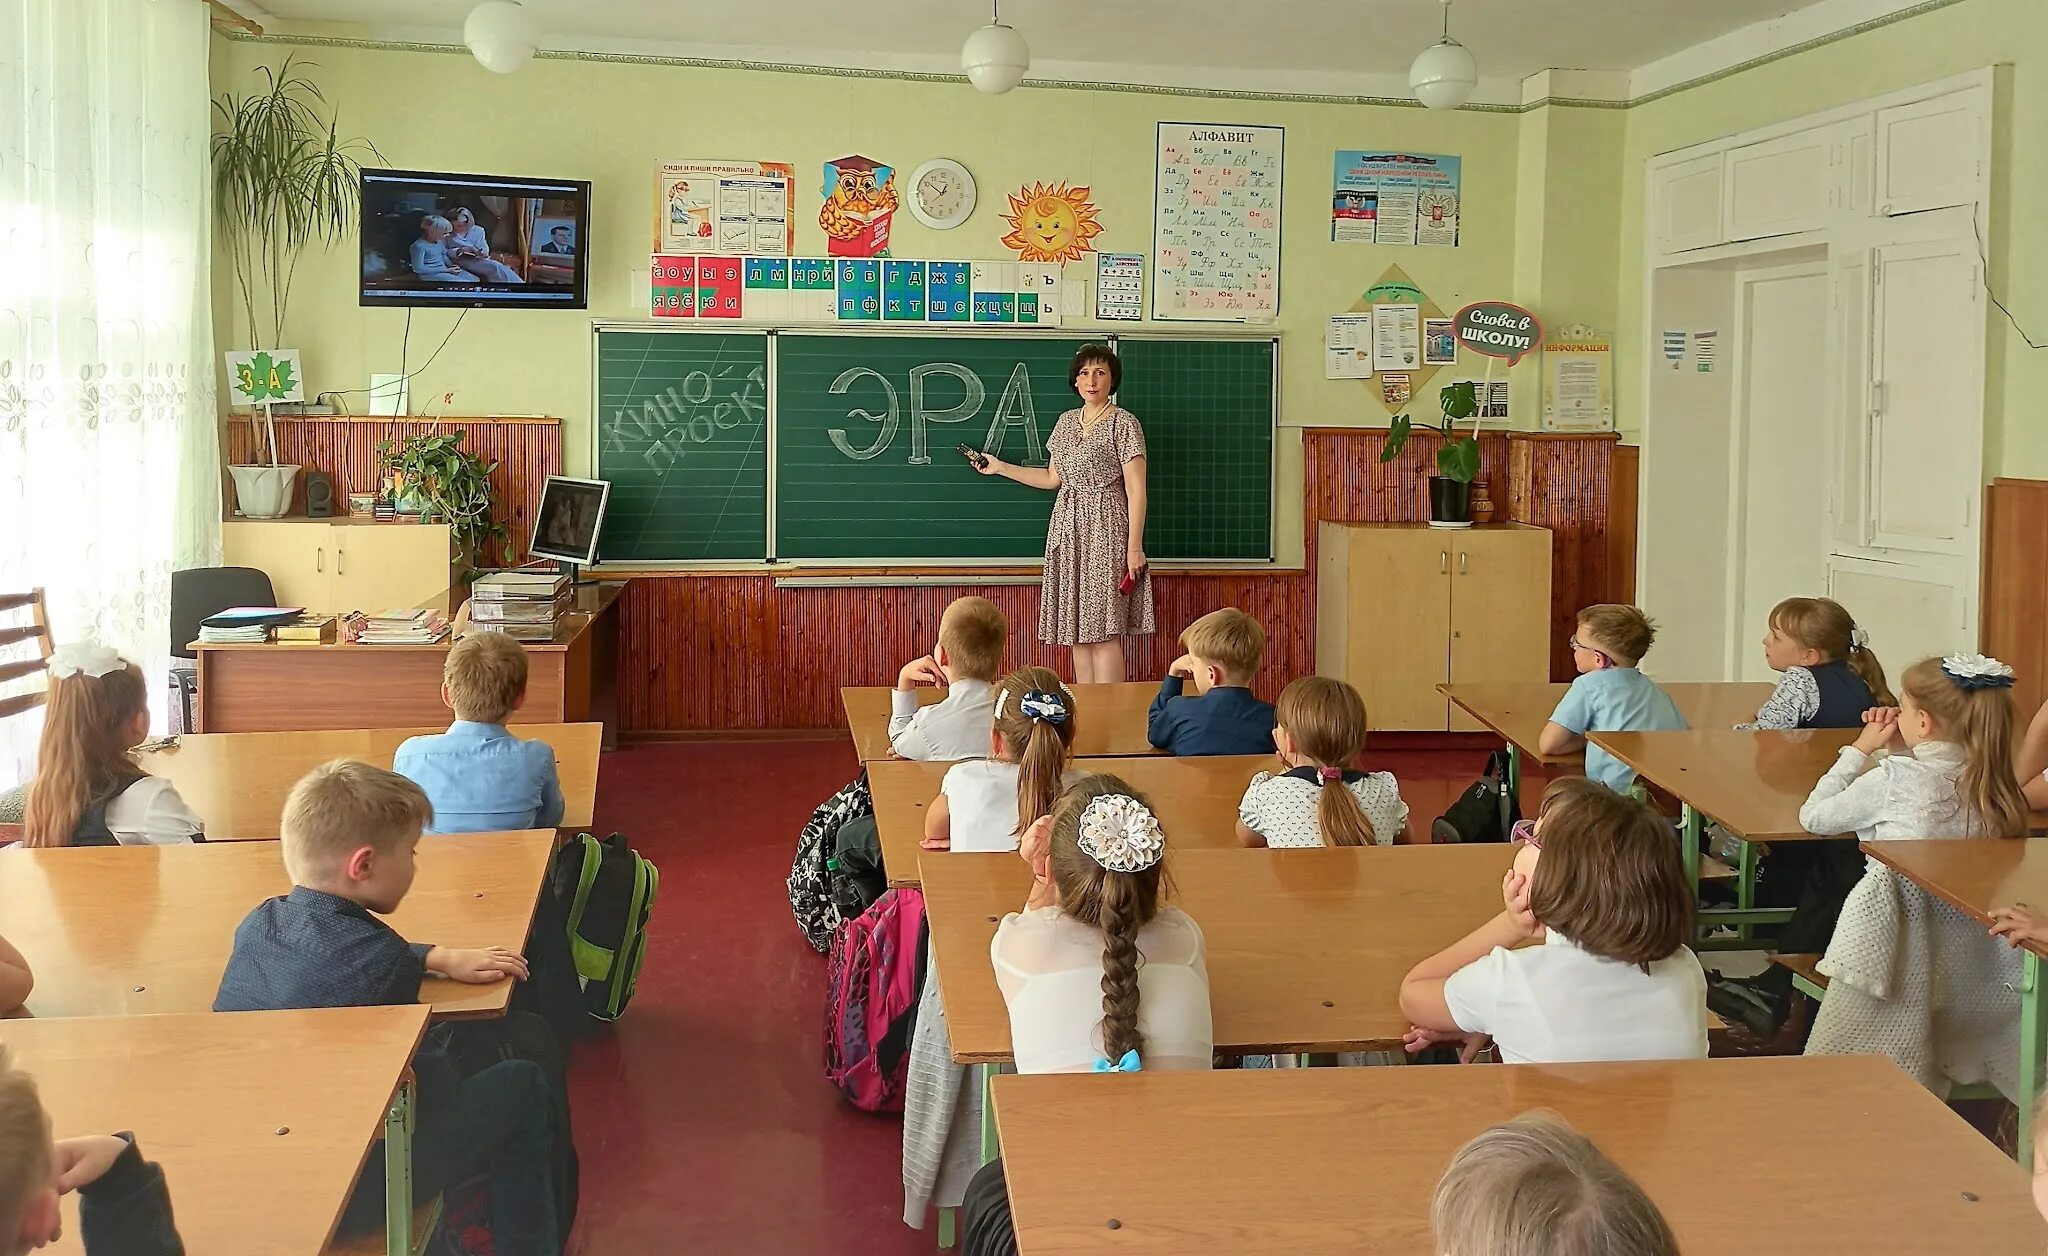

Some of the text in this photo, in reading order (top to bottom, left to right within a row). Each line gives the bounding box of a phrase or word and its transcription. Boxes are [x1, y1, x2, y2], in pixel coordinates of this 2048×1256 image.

[1189, 131, 1254, 142] АЛФАВИТ
[1470, 309, 1530, 330] Снова в
[1462, 327, 1530, 350] ШКОЛУ!
[1546, 343, 1610, 352] ИНФОРМАЦИЯ
[828, 362, 1049, 468] ЭРА
